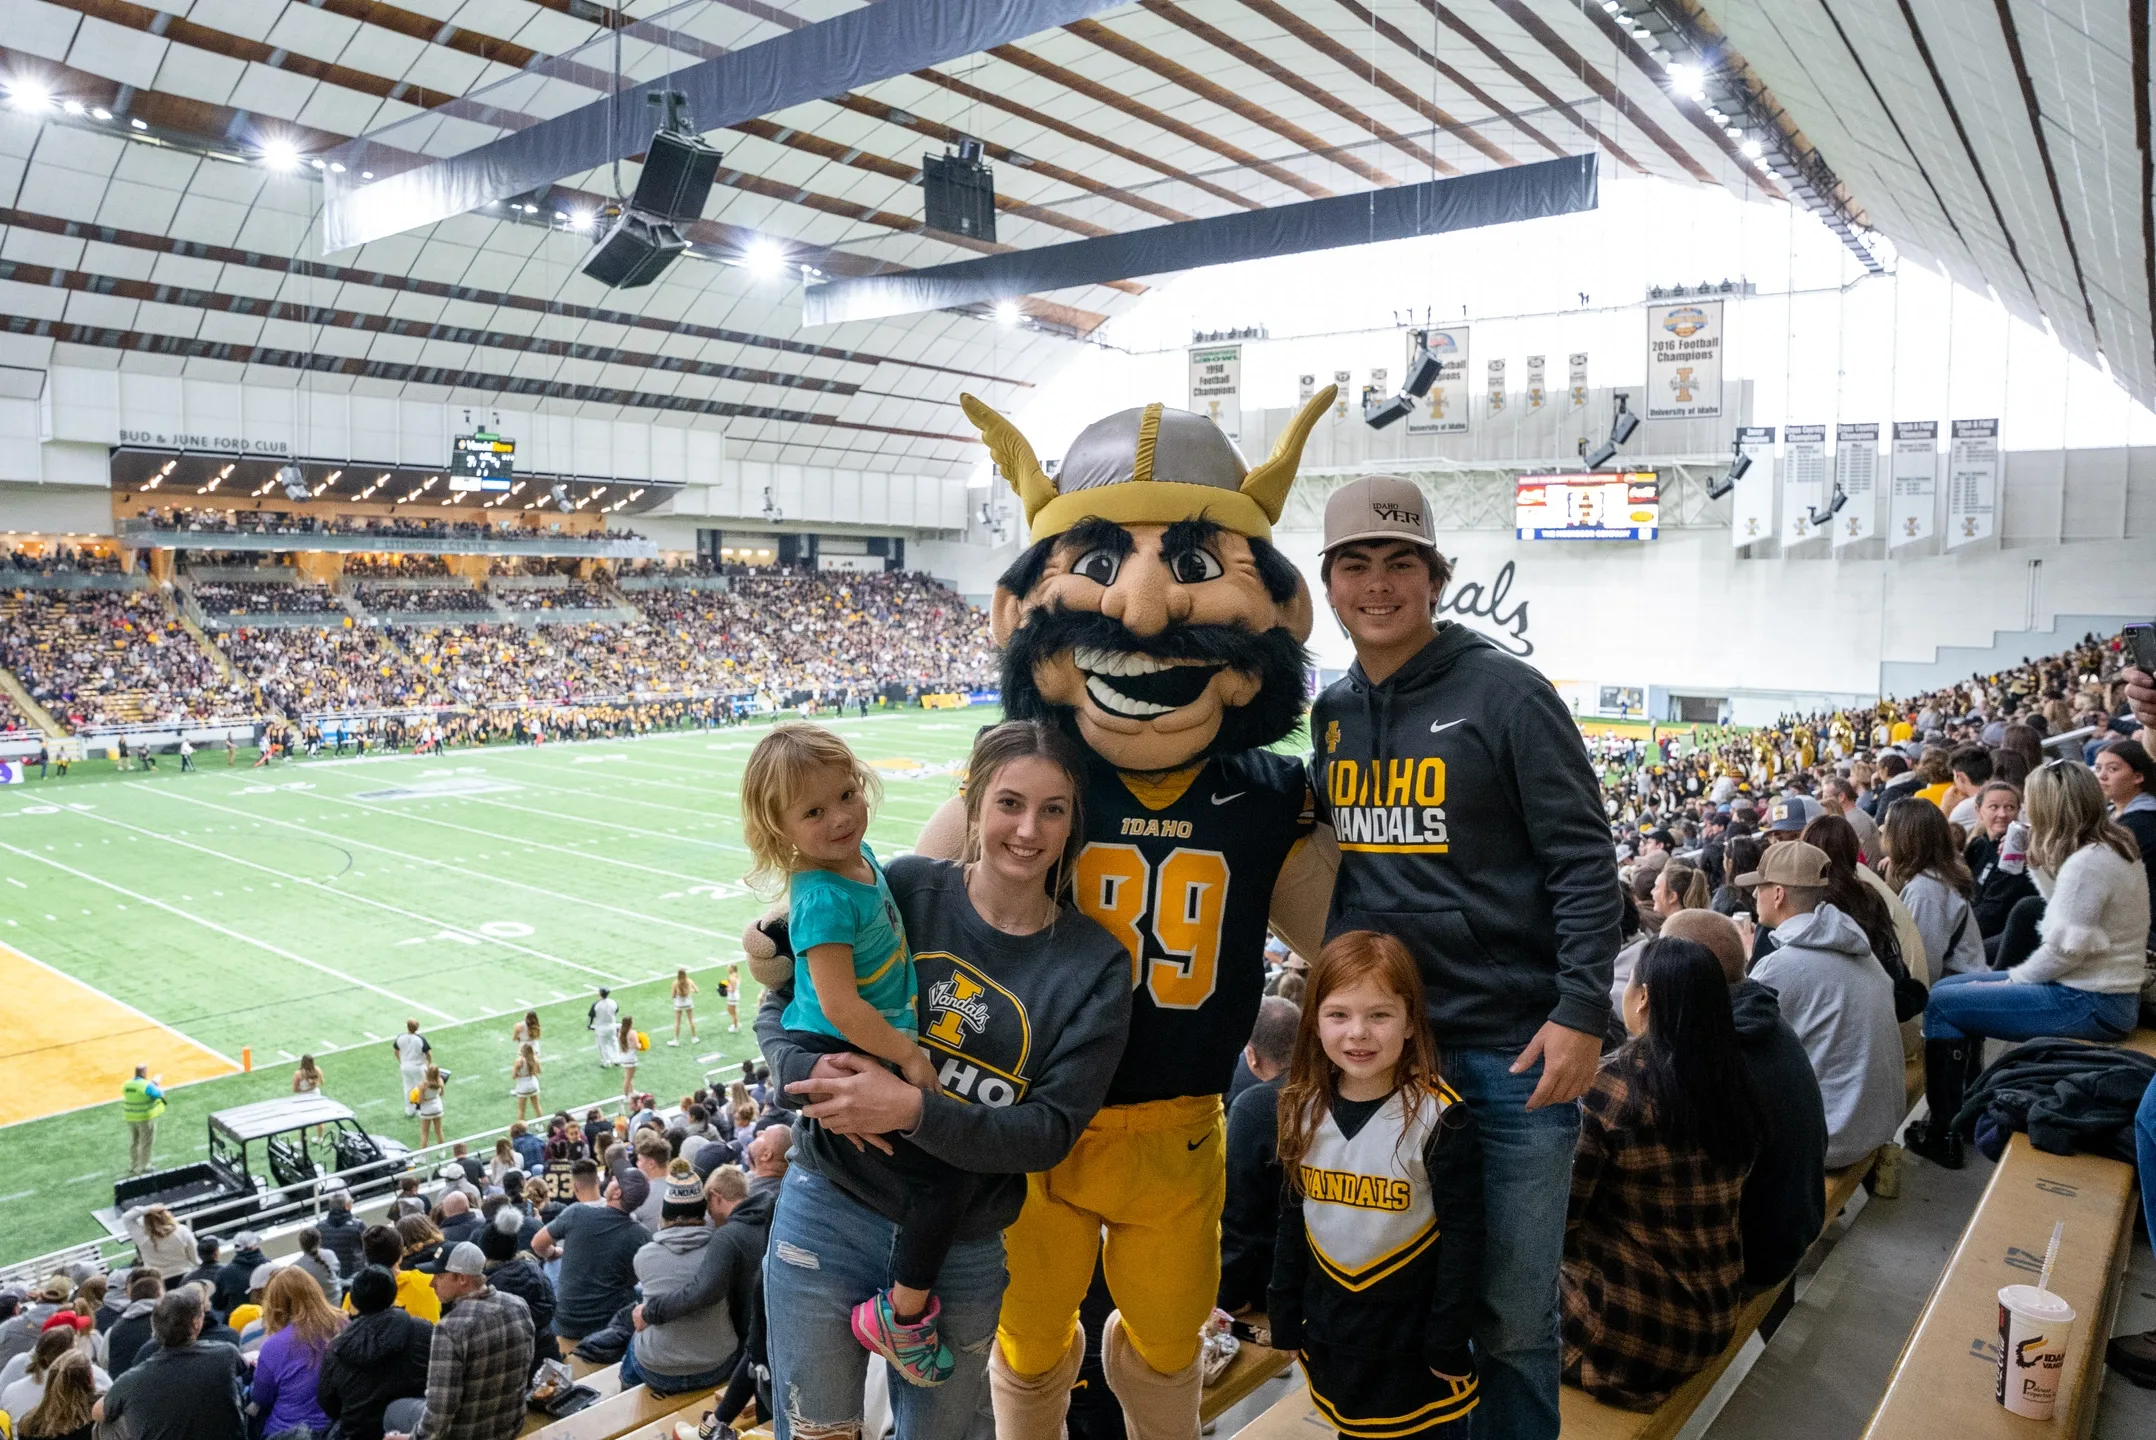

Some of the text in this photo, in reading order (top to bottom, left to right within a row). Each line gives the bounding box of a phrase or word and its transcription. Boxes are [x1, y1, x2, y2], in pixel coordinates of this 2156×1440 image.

[1652, 337, 1719, 352] 2016 Football
[1656, 350, 1713, 363] Champions
[1192, 386, 1236, 397] Champions
[1650, 408, 1686, 417] University
[1697, 405, 1719, 414] Idaho
[119, 430, 288, 452] BUD & JUNE FORD CLUB
[1372, 502, 1399, 510] IDAHO
[1121, 817, 1193, 839] IDAHO
[1331, 807, 1446, 843] VANDALS
[1072, 841, 1231, 1011] 89
[928, 979, 990, 1033] Vandals
[545, 1173, 575, 1199] 33
[1301, 1164, 1412, 1214] VANDALS
